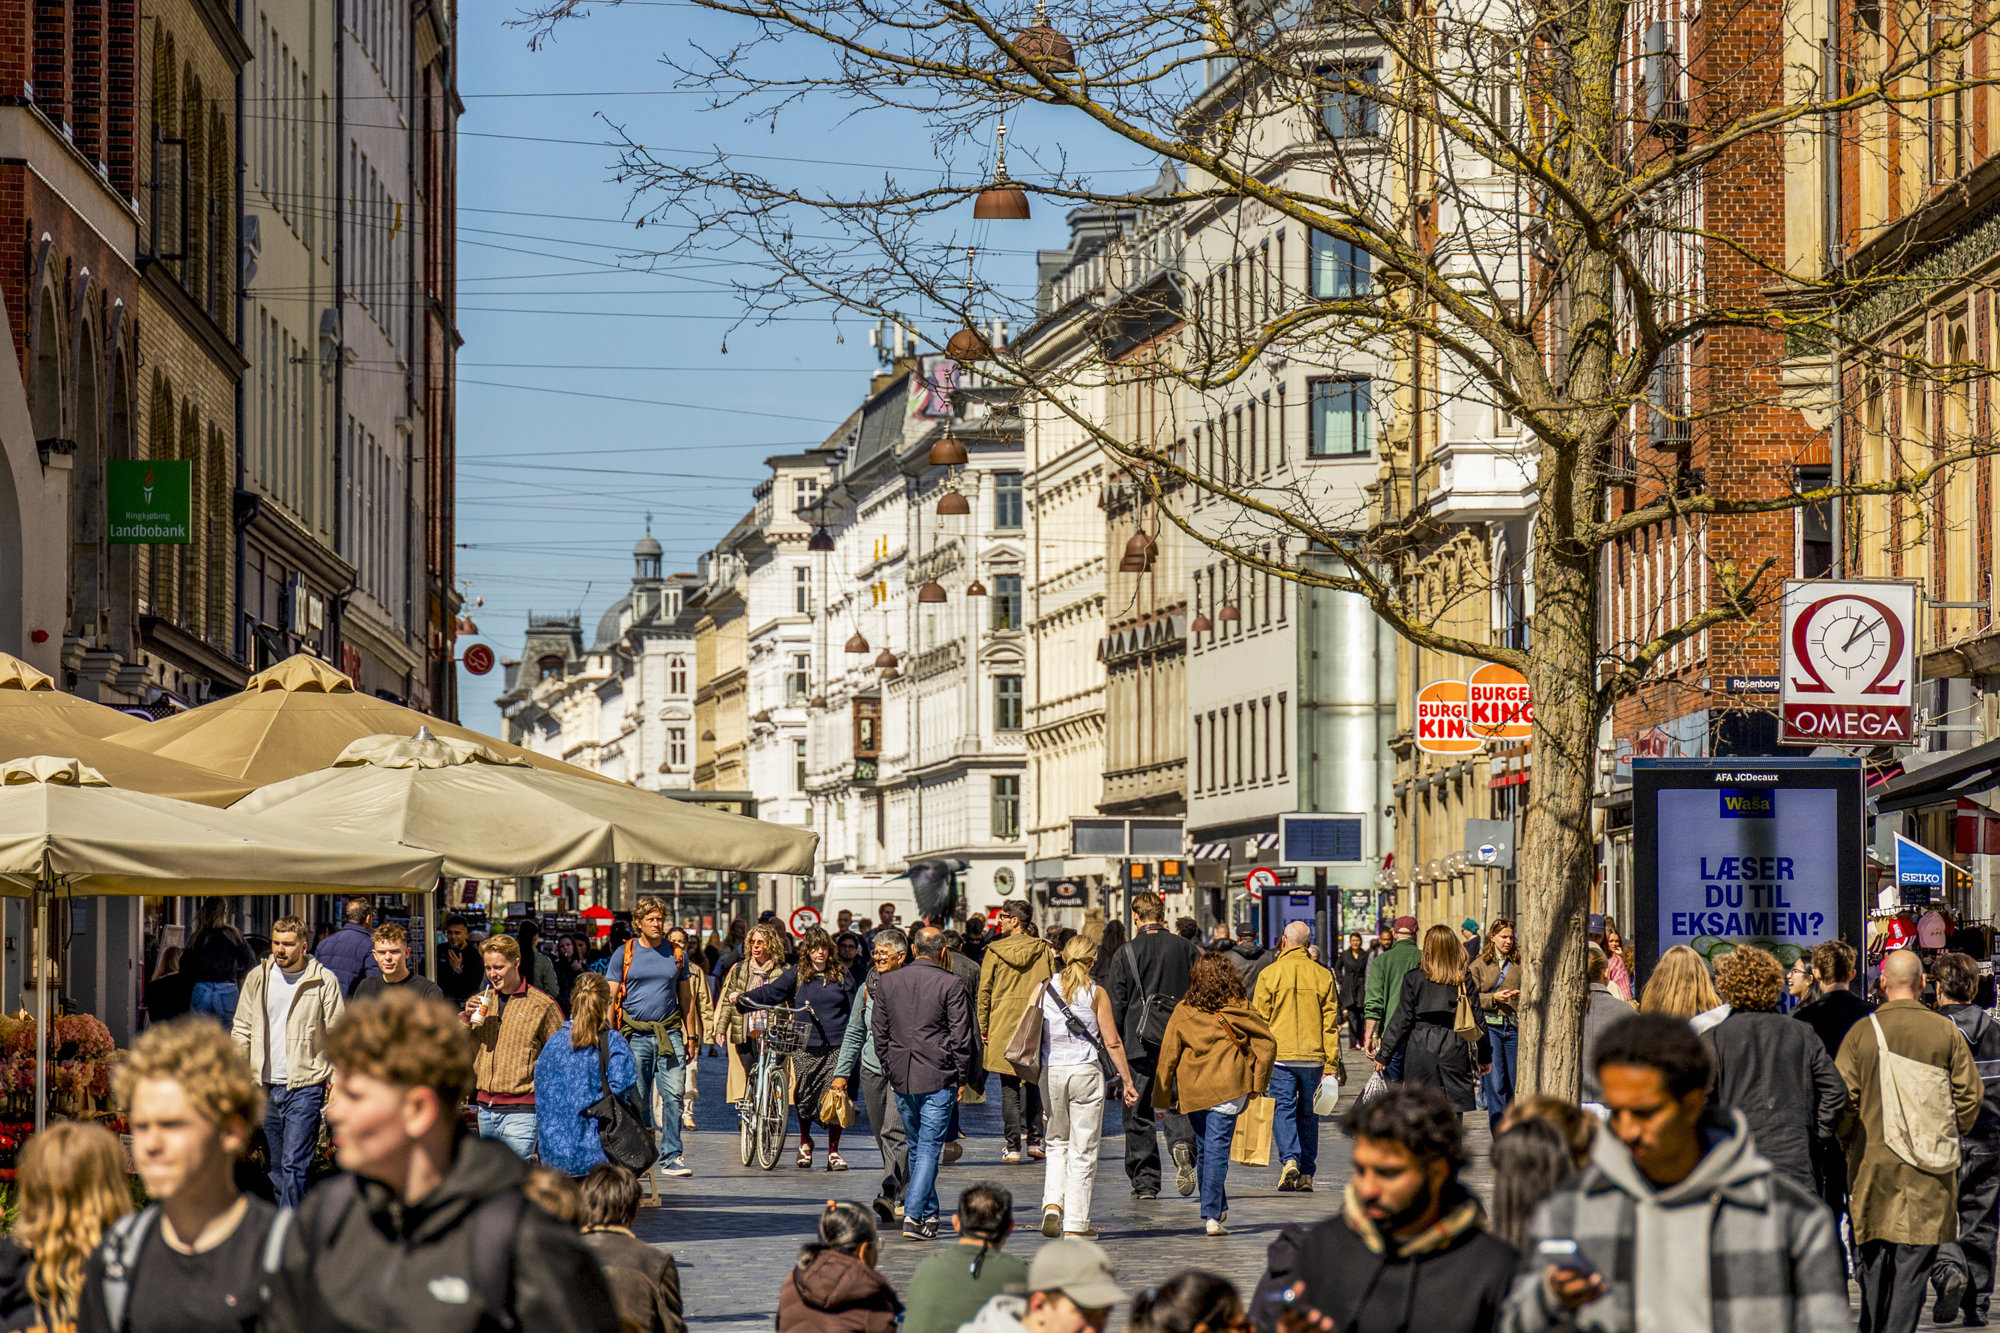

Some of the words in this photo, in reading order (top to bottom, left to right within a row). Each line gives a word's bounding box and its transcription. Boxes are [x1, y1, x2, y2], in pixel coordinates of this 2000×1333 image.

[125, 511, 171, 521] Ringkjøbing
[110, 523, 186, 537] Landbobank
[1795, 711, 1904, 736] OMEGA
[1715, 773, 1733, 782] AFA
[1735, 773, 1779, 782] JCDecaux
[1724, 796, 1770, 810] Wasa
[1700, 856, 1795, 881] LÆSER
[1901, 872, 1940, 883] SEIKO
[1705, 884, 1743, 908] DU
[1748, 884, 1791, 908] TIL
[1672, 912, 1824, 936] EKSAMEN?
